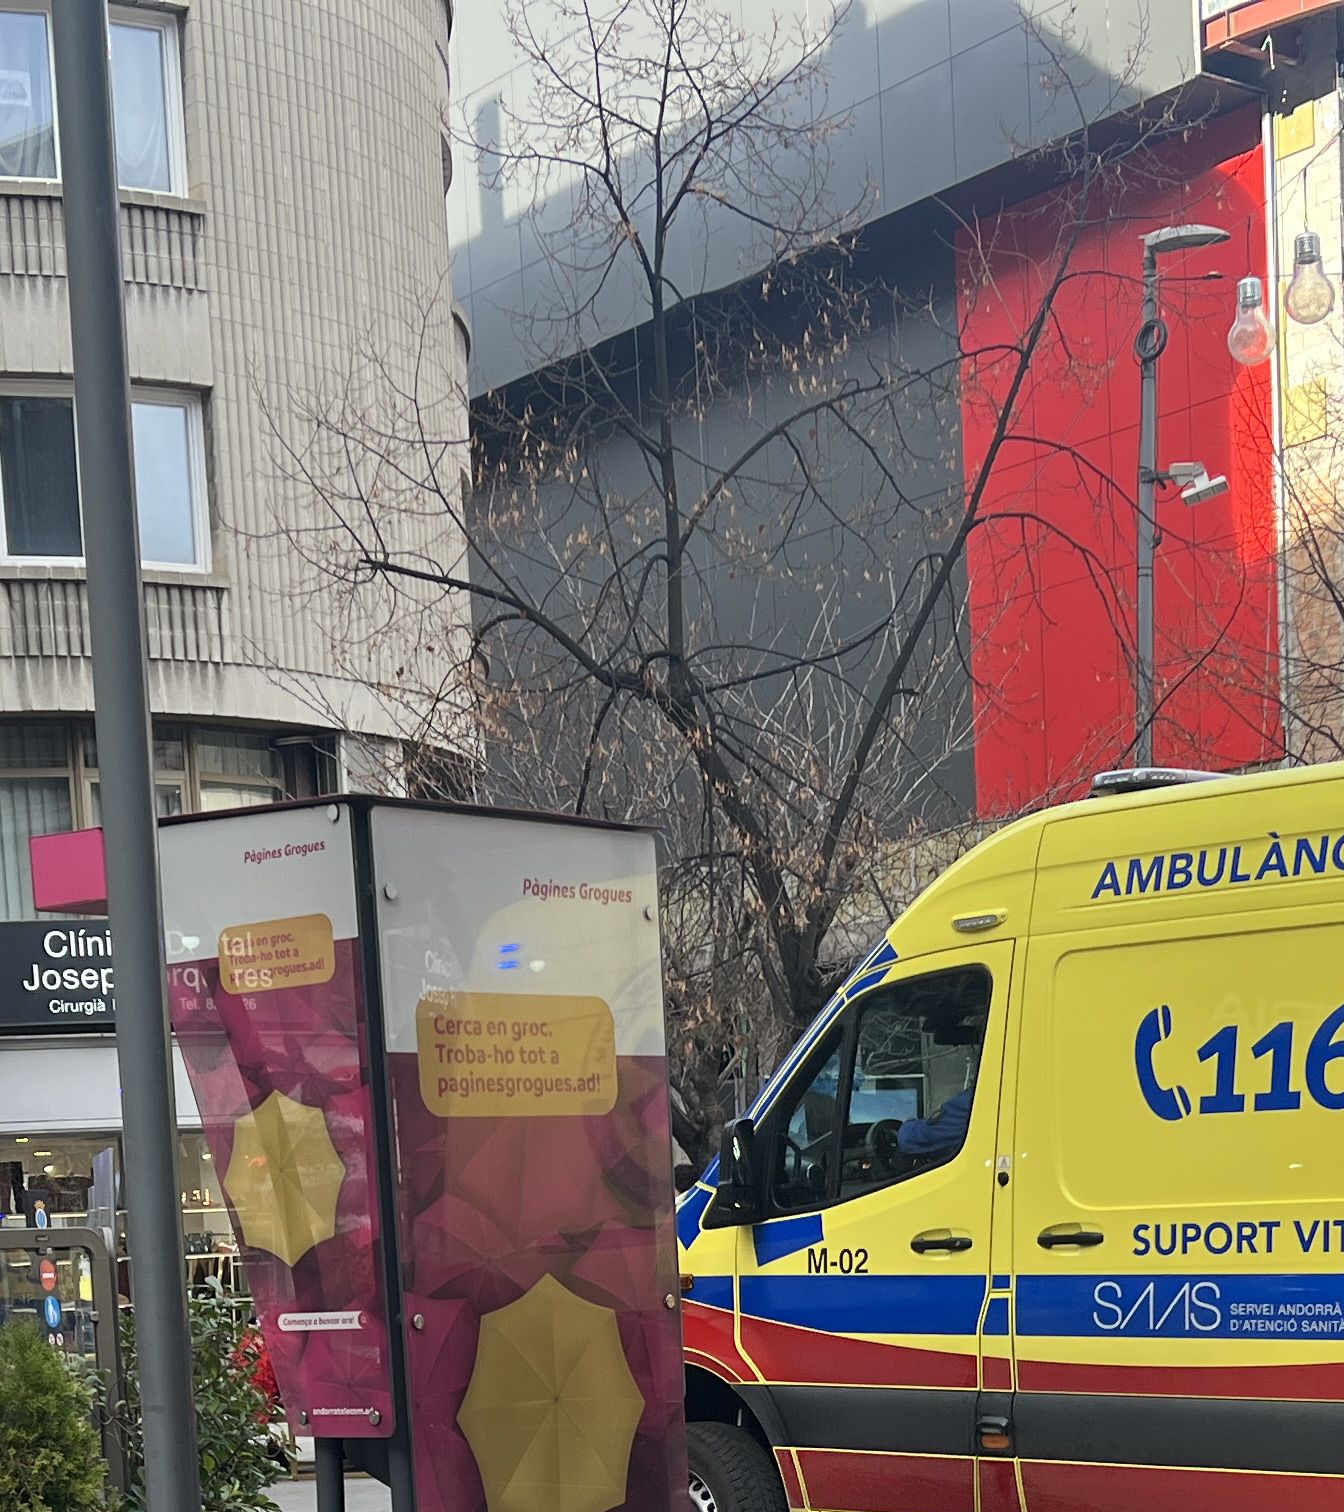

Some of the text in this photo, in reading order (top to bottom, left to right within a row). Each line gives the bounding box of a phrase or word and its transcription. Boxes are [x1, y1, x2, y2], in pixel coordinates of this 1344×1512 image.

[244, 841, 325, 864] Pàgines Grogues
[523, 878, 632, 905] Pàgines Grogues
[43, 929, 112, 958] Clíni
[48, 998, 106, 1016] Cirurgià
[434, 1014, 553, 1041] Cerca en groc.
[434, 1044, 560, 1065] Troba-ho tot a
[437, 1072, 601, 1098] paginesgrogues.ad!
[1132, 1220, 1281, 1256] SUPORT
[807, 1247, 869, 1275] M-02
[1229, 1301, 1343, 1317] SERVEI ANDORRÀ
[1229, 1317, 1298, 1333] D'ATENCIÓ
